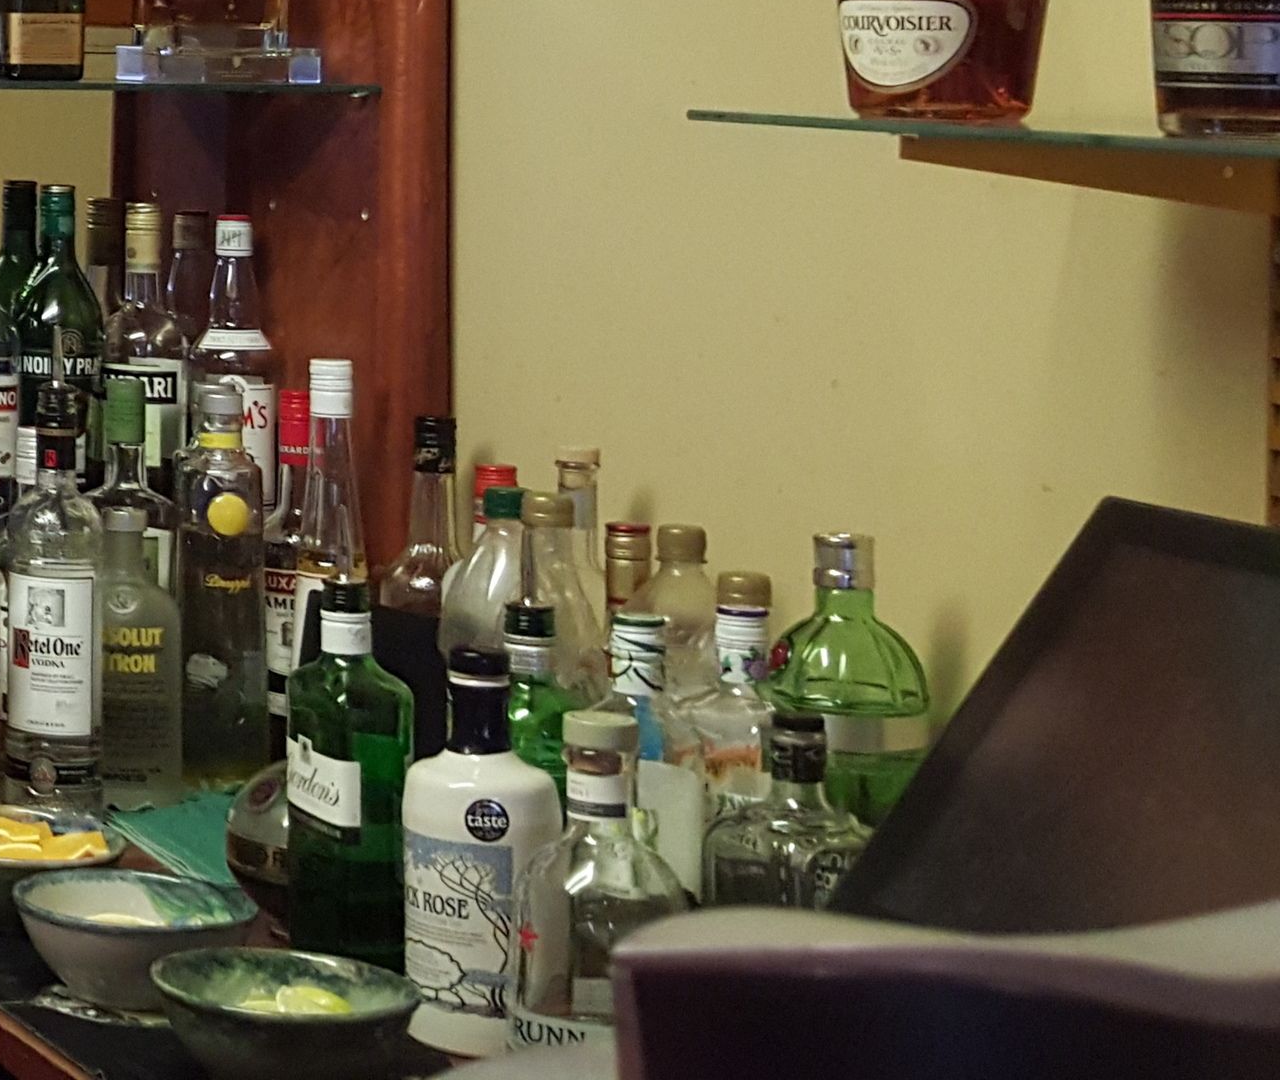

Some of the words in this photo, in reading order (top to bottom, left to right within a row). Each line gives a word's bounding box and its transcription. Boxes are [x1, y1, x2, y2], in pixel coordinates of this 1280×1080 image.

[842, 14, 953, 37] COURVOISIER
[23, 356, 75, 376] NOIY
[13, 628, 51, 667] Ketel
[53, 638, 82, 657] One
[31, 658, 66, 668] VODKA
[467, 812, 508, 829] taste
[423, 890, 470, 920] ROSE
